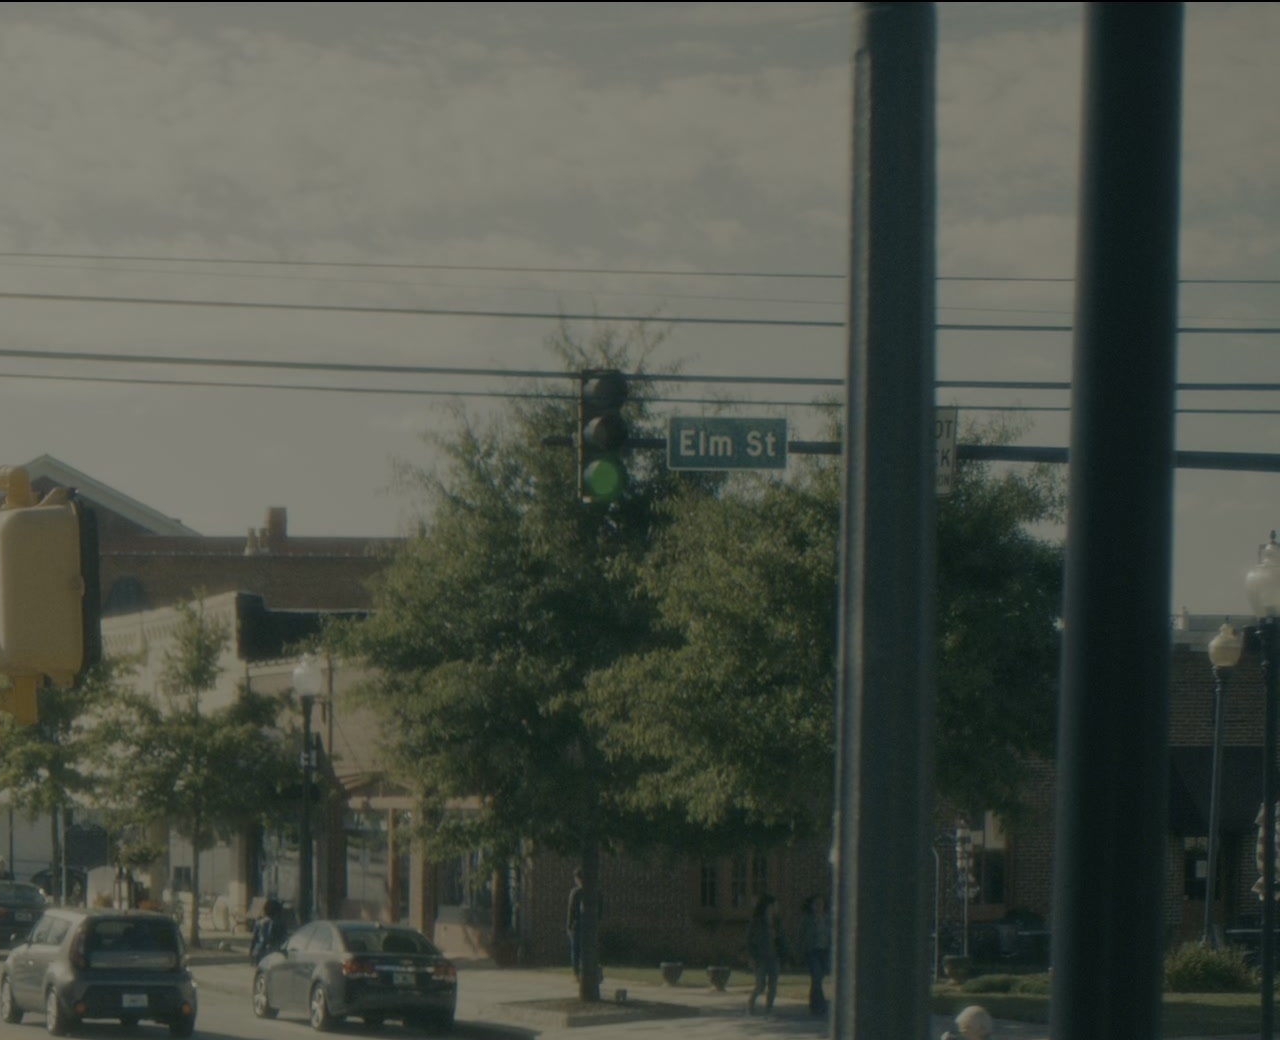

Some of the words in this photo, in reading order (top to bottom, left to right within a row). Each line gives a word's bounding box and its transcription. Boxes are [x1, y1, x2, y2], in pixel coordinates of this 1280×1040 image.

[934, 420, 954, 439] OT
[679, 429, 734, 457] Elm
[745, 430, 777, 457] St
